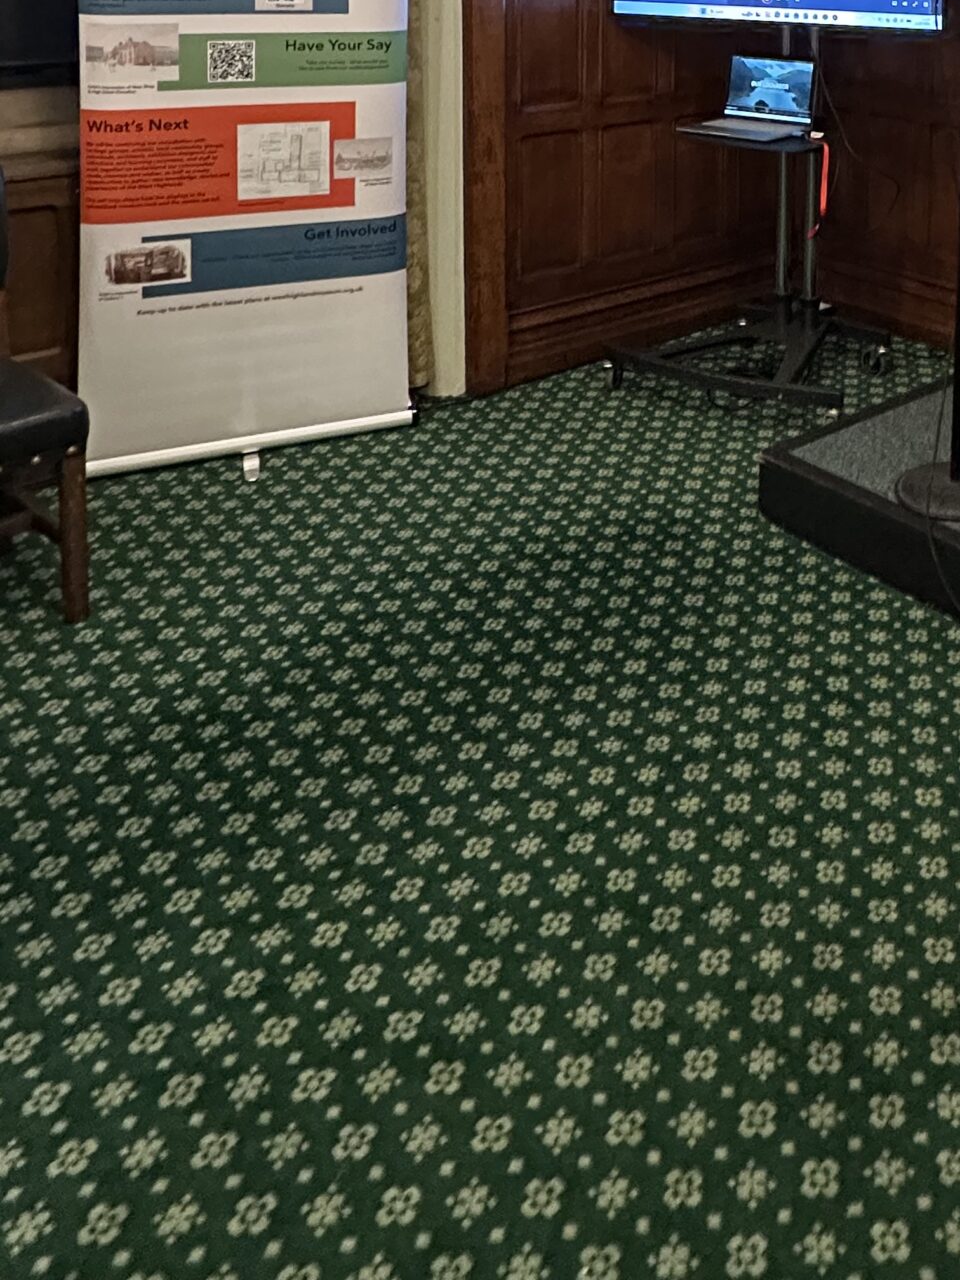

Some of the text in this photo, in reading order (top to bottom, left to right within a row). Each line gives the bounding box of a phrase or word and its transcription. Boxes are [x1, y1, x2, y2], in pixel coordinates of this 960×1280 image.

[285, 38, 392, 53] Have Your Say
[87, 118, 189, 133] What's Next
[304, 220, 397, 241] Get Involved
